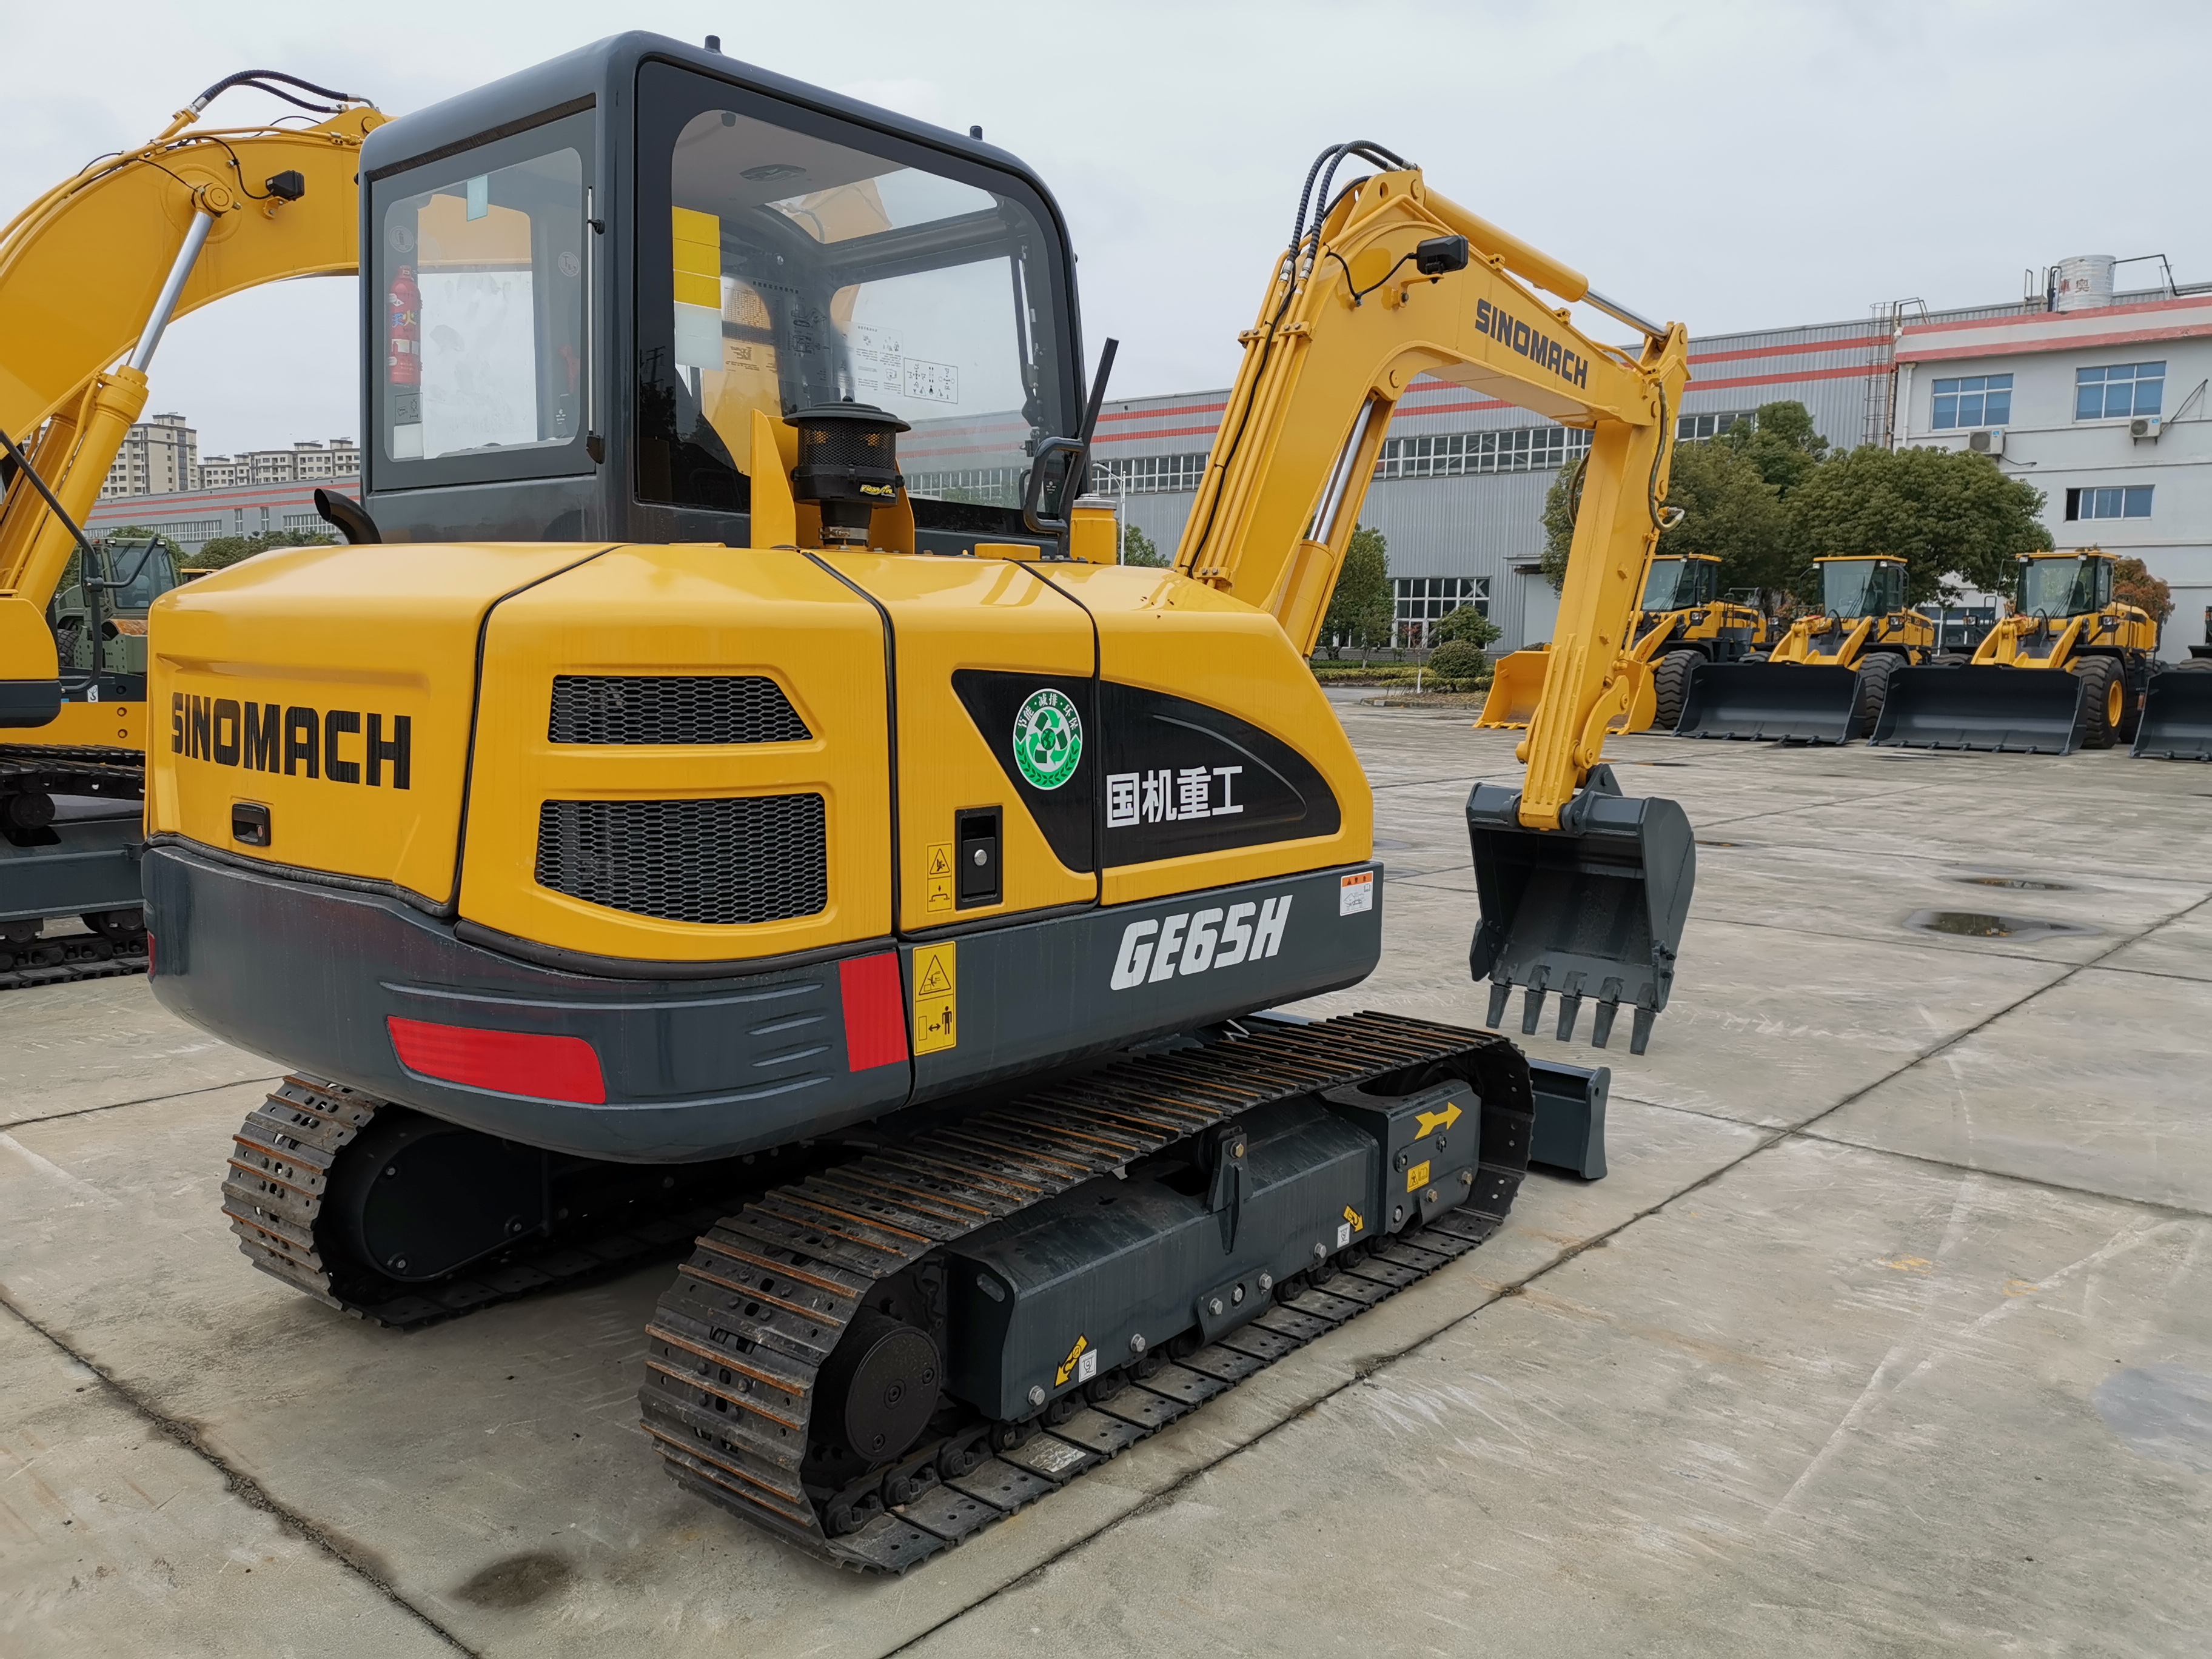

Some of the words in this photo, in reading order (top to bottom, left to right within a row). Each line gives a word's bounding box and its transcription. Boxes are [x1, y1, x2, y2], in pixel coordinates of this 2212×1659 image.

[1475, 298, 1589, 390] SINOMACH
[171, 692, 412, 790] SINOMACH
[1107, 765, 1244, 828] 国机重工
[1110, 894, 1293, 991] GE65H
